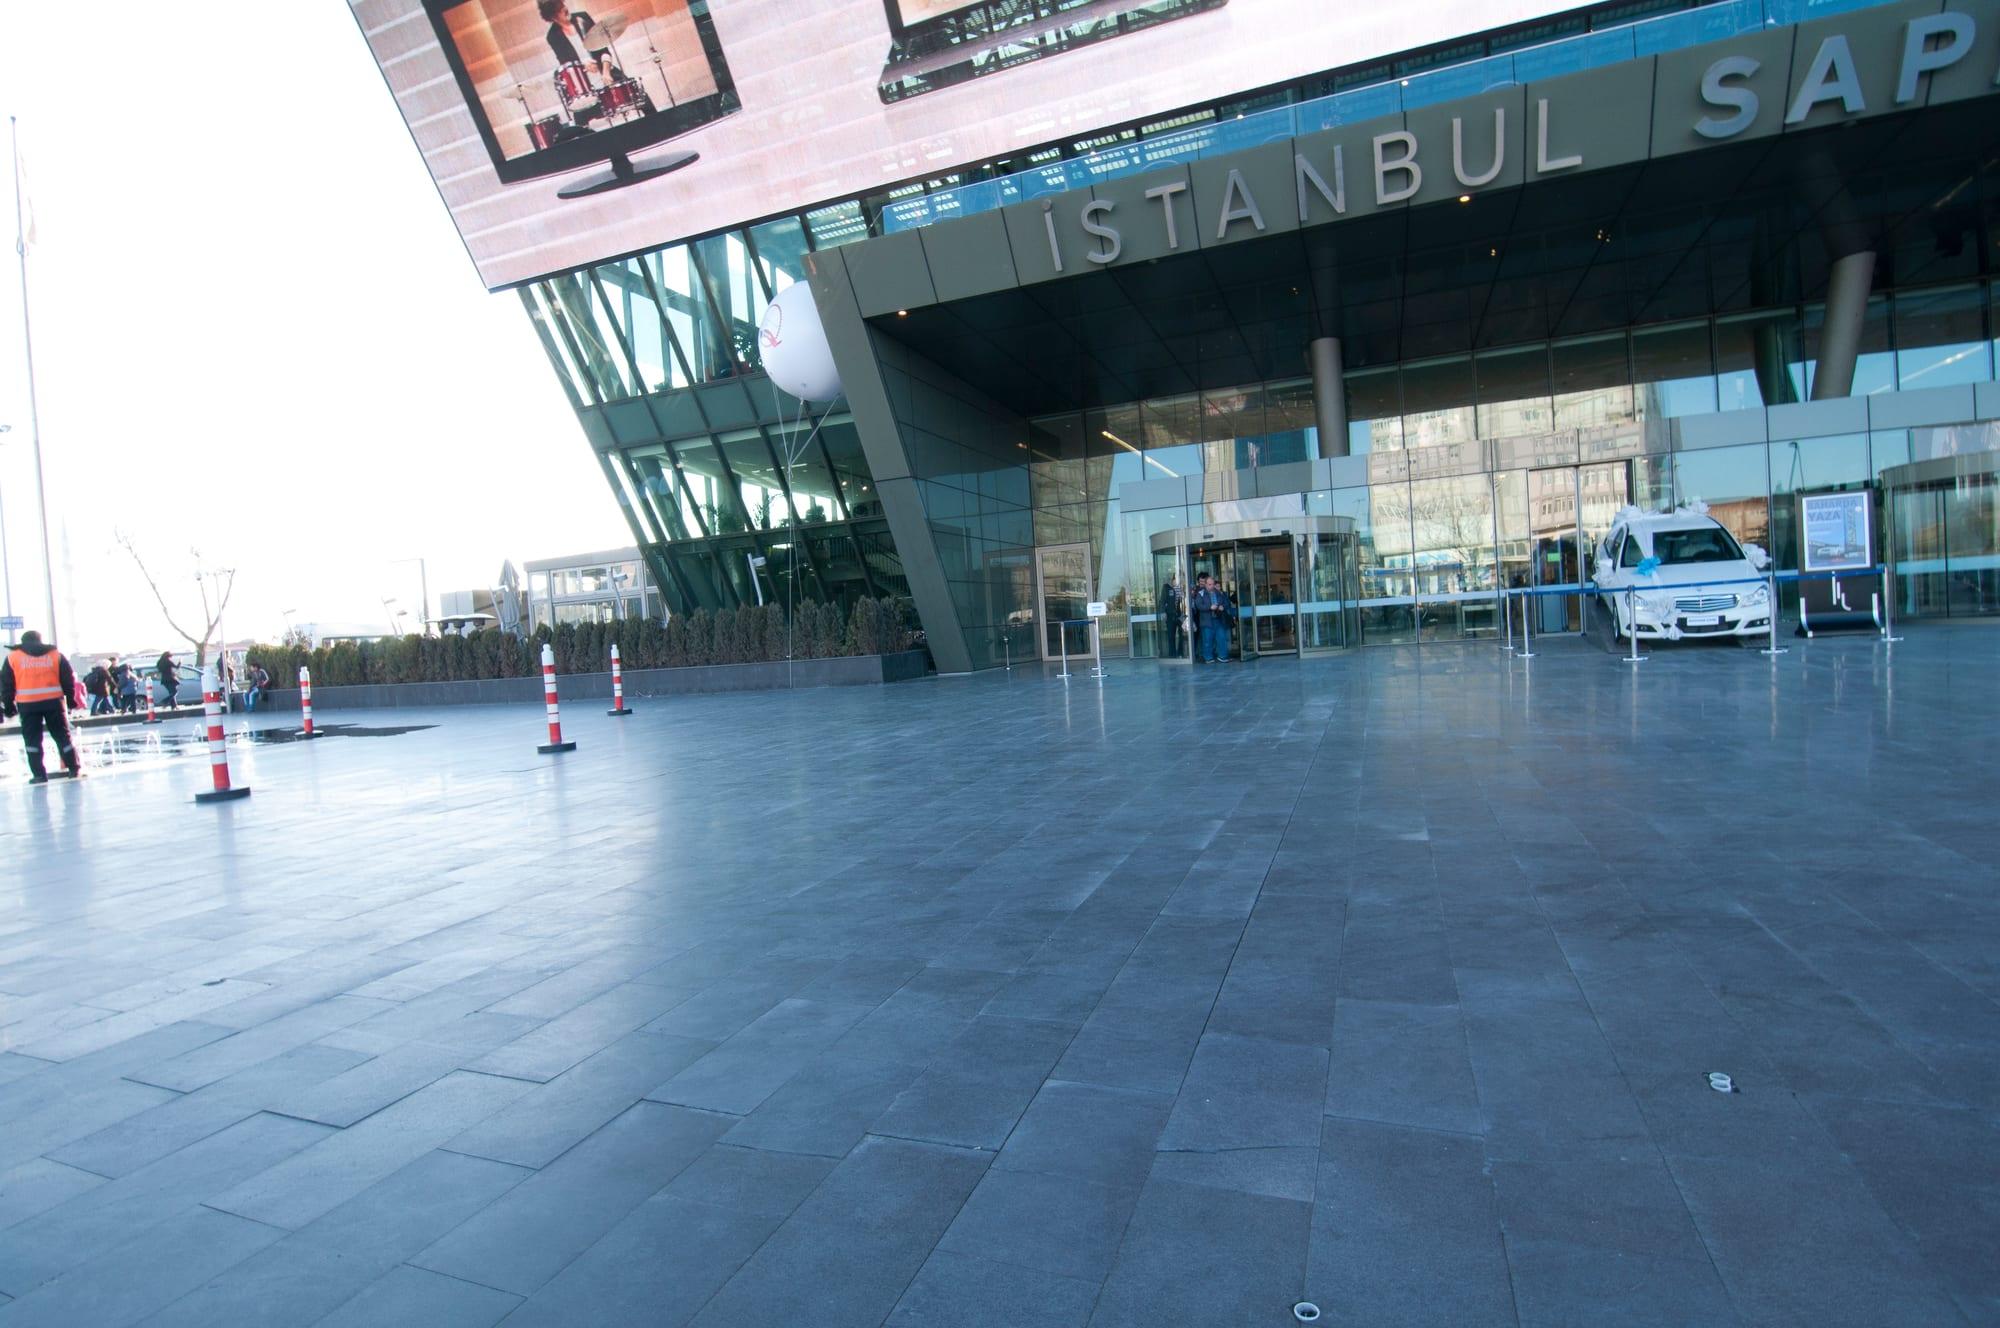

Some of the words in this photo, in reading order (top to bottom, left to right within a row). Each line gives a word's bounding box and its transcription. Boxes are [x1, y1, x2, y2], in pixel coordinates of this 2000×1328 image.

[1043, 98, 1583, 272] İSTANBUL
[1692, 11, 2000, 138] SAP
[1808, 511, 1841, 522] YAZA
